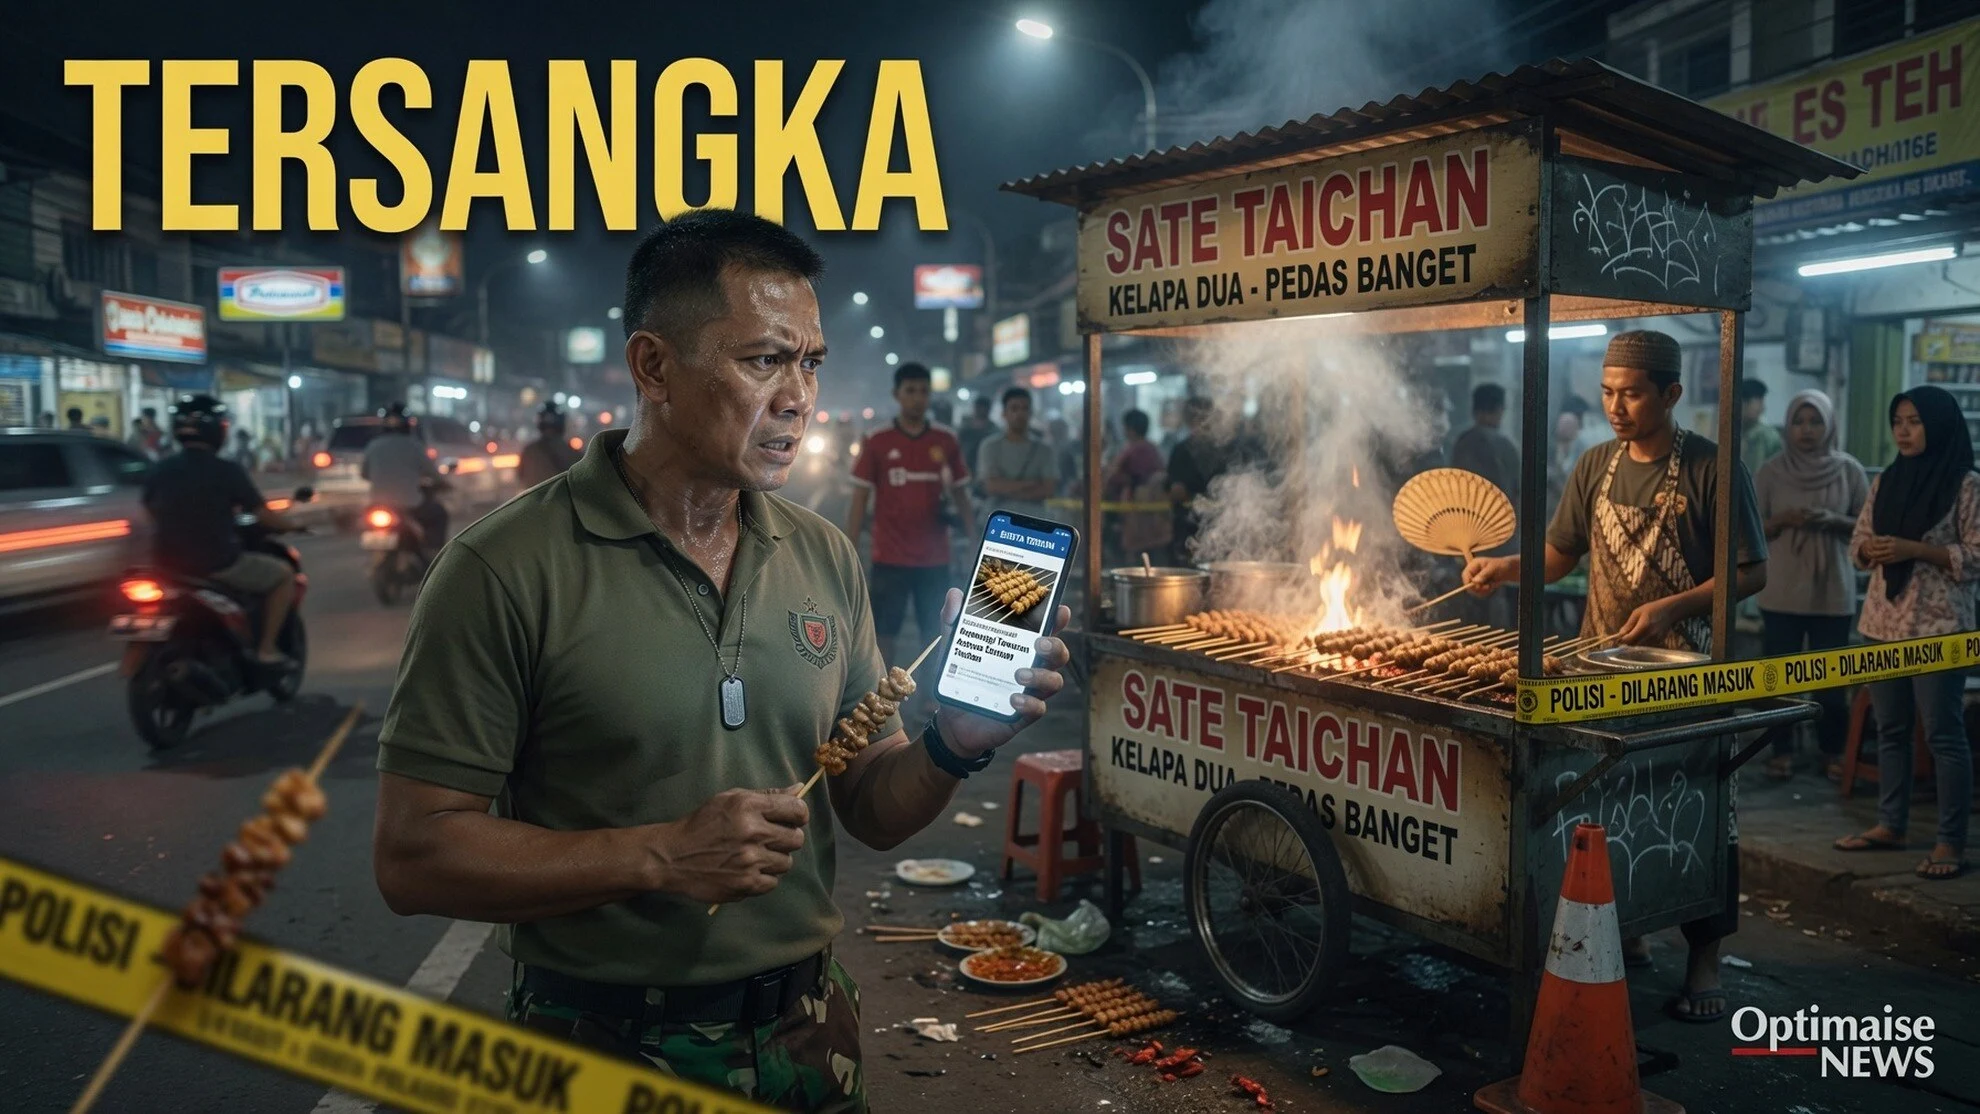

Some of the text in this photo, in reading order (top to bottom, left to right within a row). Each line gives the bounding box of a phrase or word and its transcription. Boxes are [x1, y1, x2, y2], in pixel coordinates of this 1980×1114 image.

[1794, 80, 1846, 144] ES
[1862, 44, 1962, 128] TEH
[1106, 197, 1218, 274] SATE
[1234, 150, 1488, 257] TAICHAN
[1109, 277, 1189, 316] KELAPA
[1200, 272, 1243, 307] DUA
[1266, 259, 1347, 301] PEDAS
[1357, 244, 1476, 293] BANGET
[1551, 684, 1604, 714] POLISI
[1622, 674, 1698, 705] DILARANG
[1703, 667, 1755, 695] MASUK
[1785, 657, 1826, 684] POLISI
[1840, 648, 1899, 676] DILARANG
[1904, 641, 1944, 667] MASUK
[1112, 736, 1458, 865] KELAPA DUA BANGET
[1123, 673, 1223, 750] SATE
[1238, 697, 1459, 812] TAICHAN
[0, 877, 140, 973] POLISI
[180, 948, 402, 1055] ILARANG
[408, 1013, 581, 1112] MASUK
